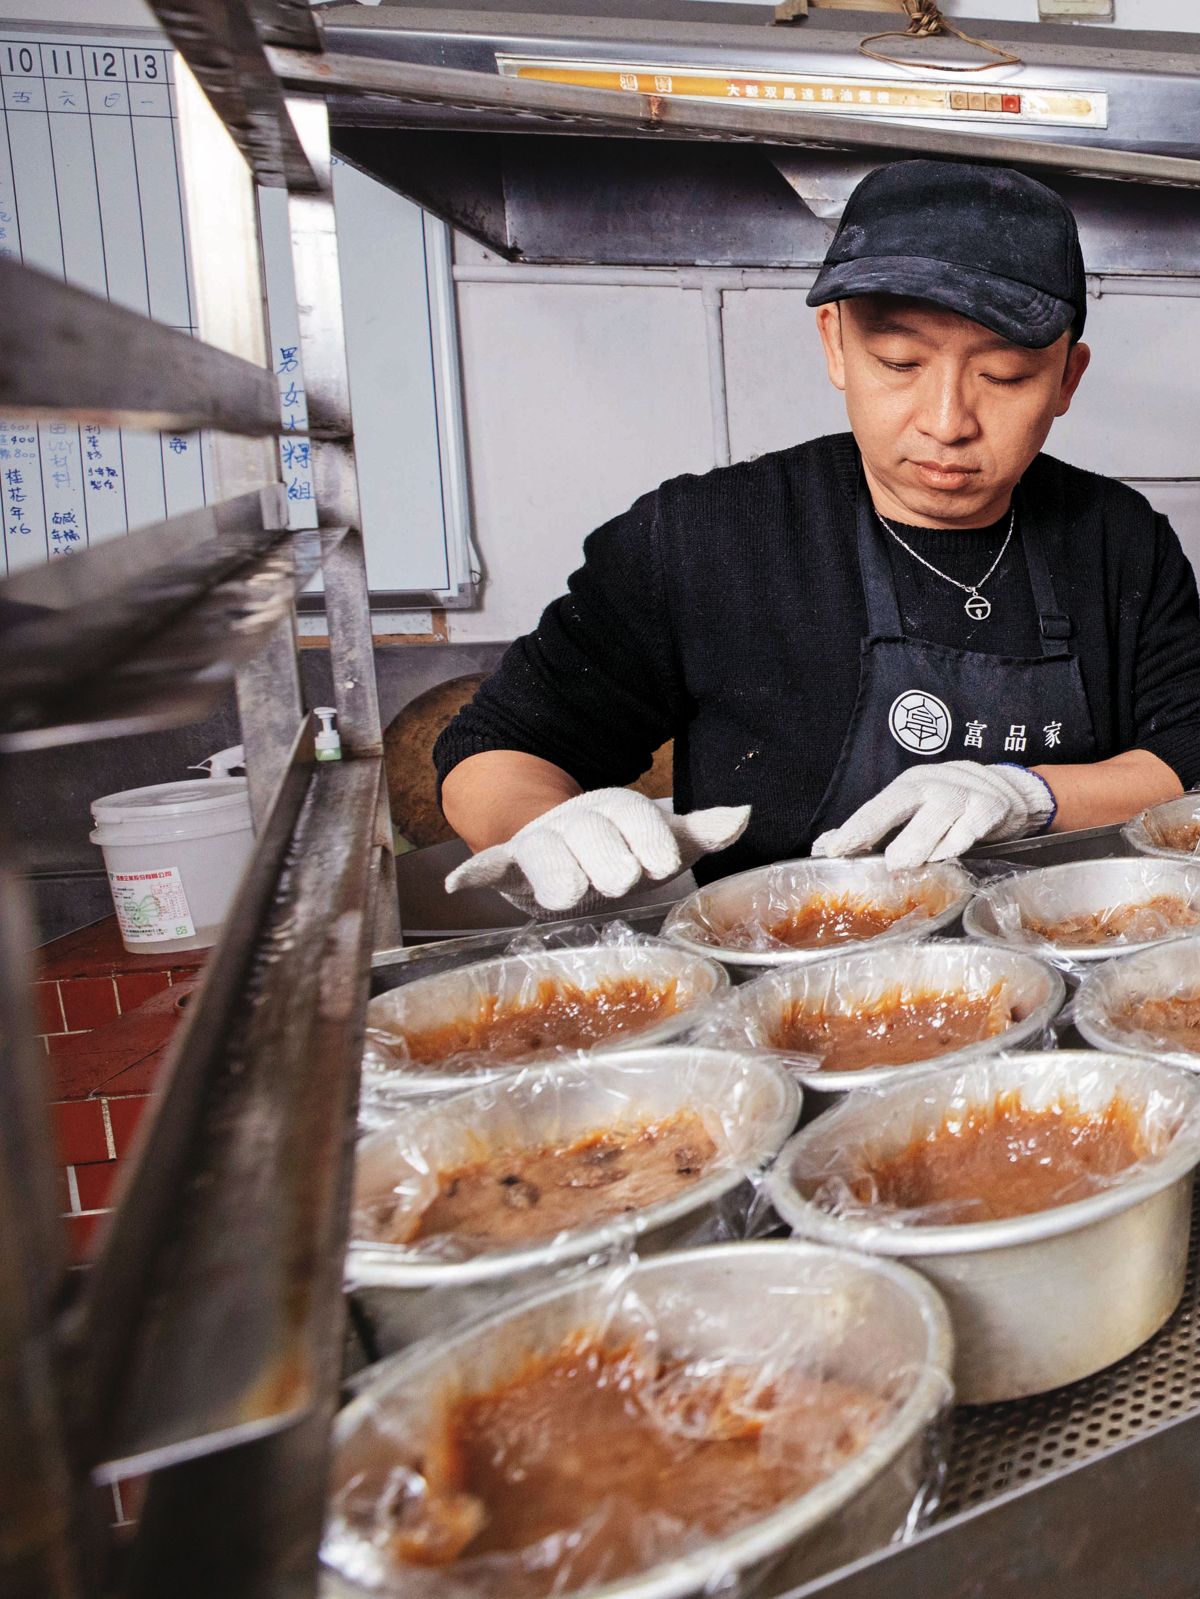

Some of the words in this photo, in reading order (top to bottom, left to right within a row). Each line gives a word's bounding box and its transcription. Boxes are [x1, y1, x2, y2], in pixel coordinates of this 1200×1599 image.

[8, 47, 33, 73] 10
[52, 49, 73, 75] 11
[92, 51, 117, 77] 12
[133, 54, 158, 79] 13
[963, 720, 1063, 753] 富品家
